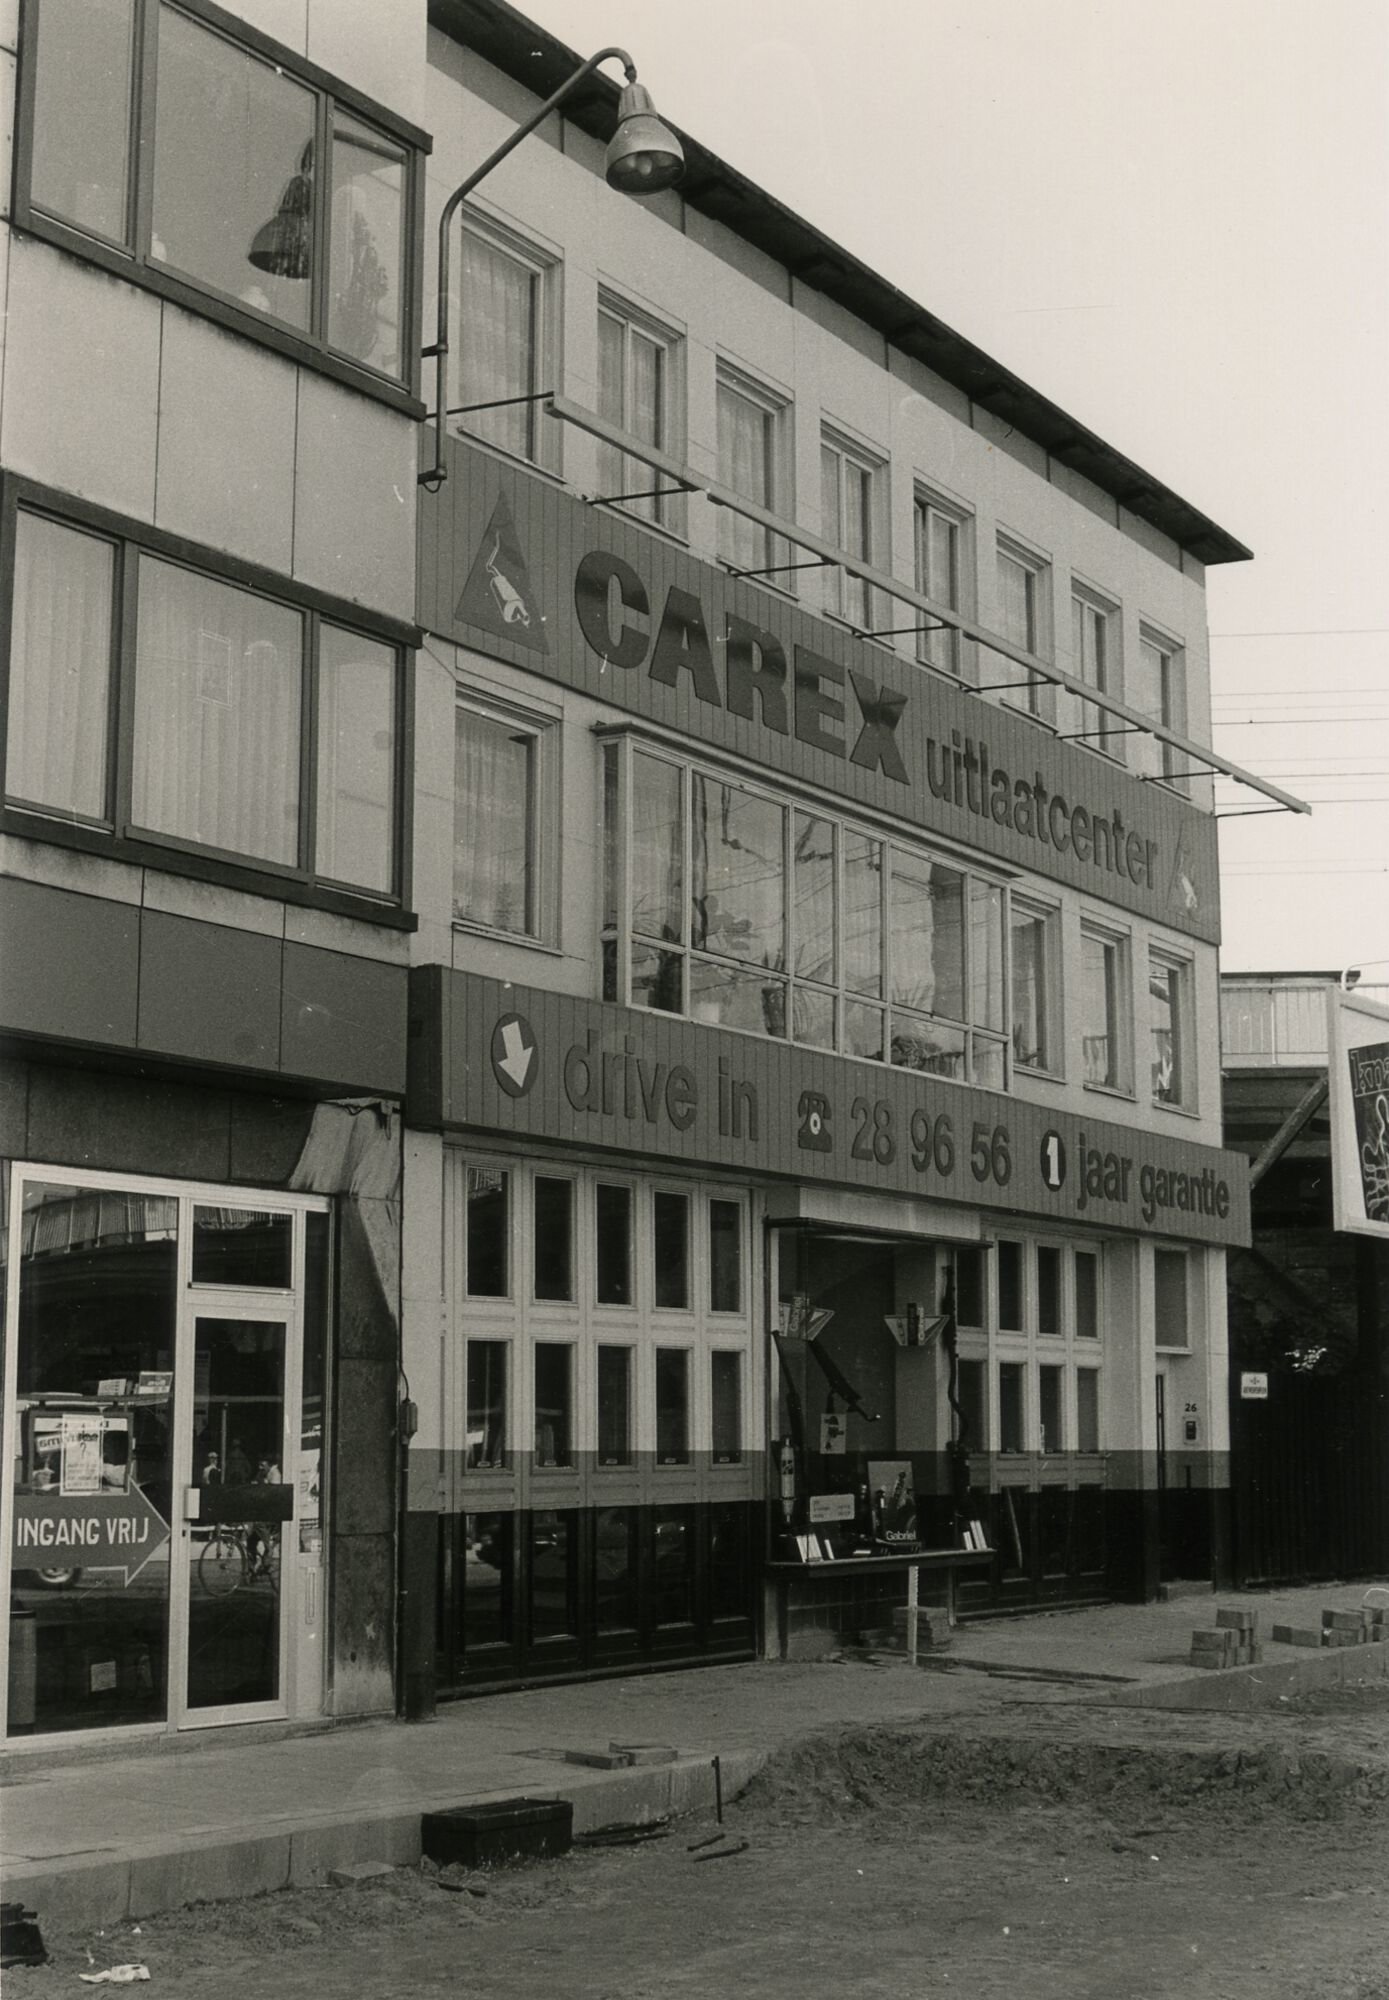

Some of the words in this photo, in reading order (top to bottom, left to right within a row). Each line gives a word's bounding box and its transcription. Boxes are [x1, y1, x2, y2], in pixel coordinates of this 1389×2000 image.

[574, 549, 910, 786] CAREX
[926, 728, 1158, 891] uitlaatcenter
[563, 1028, 698, 1132] drive
[717, 1055, 759, 1142] in
[850, 1096, 897, 1165] 28
[910, 1108, 956, 1176] 96
[970, 1122, 1013, 1187] 56
[1045, 1135, 1064, 1188] 1
[1076, 1132, 1131, 1208] jaar
[1140, 1166, 1231, 1224] garantie
[1185, 1403, 1198, 1413] 26
[16, 1517, 101, 1547] INGANG
[106, 1516, 150, 1545] VRIJ
[885, 1529, 917, 1542] Gabriel
